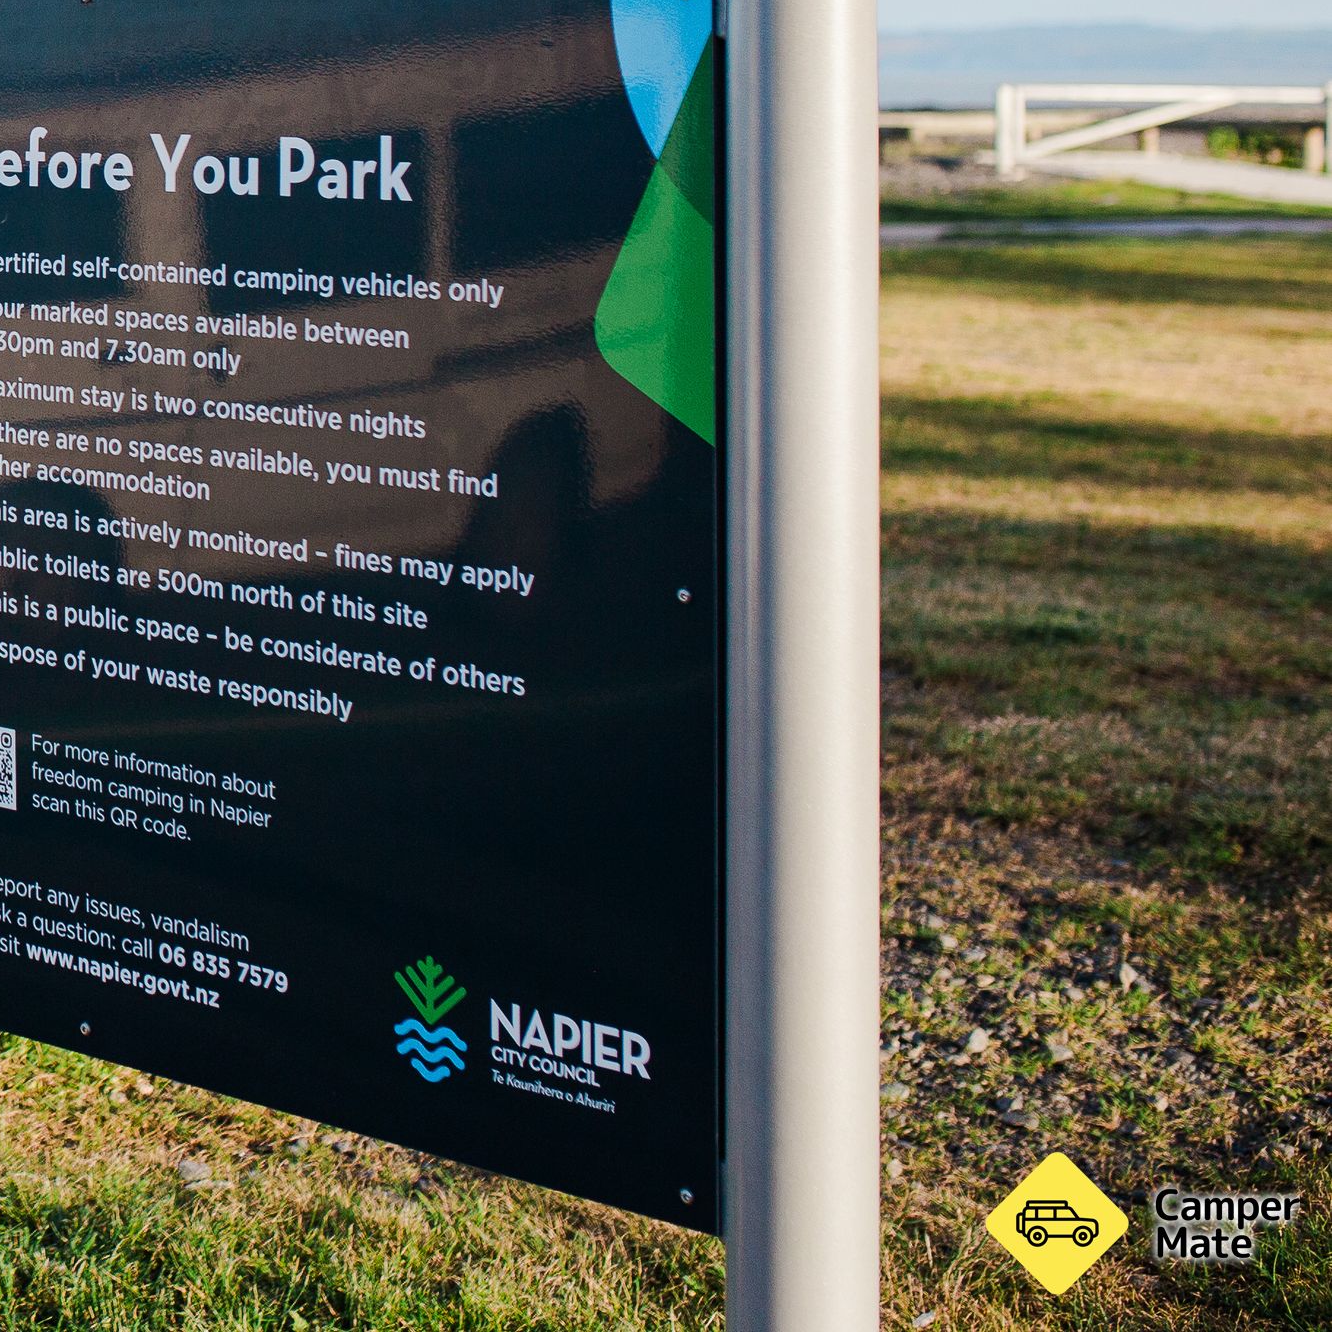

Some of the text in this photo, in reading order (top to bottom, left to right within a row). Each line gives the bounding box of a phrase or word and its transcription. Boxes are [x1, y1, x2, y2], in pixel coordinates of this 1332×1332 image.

[149, 133, 259, 196] You
[279, 134, 413, 202] Park
[72, 256, 227, 287] self-contained
[233, 267, 334, 298] camping
[341, 271, 442, 300] vehicles
[448, 278, 505, 309] only
[30, 301, 108, 326] marked
[114, 310, 189, 333] spaces
[194, 313, 298, 341] available
[304, 317, 410, 349] between
[60, 337, 99, 360] and
[106, 338, 186, 367] 7.30am
[192, 347, 242, 376] only
[80, 385, 125, 413] stay
[131, 387, 148, 411] is
[153, 390, 197, 416] two
[202, 399, 343, 431] consecutive
[349, 409, 426, 440] nights
[36, 463, 210, 501] accommodation
[55, 432, 89, 452] are
[95, 436, 123, 456] no
[128, 440, 204, 465] spaces
[209, 447, 319, 482] available,
[326, 461, 371, 485] you
[379, 467, 441, 492] must
[447, 468, 498, 498] find
[23, 508, 68, 530] area
[74, 509, 91, 533] is
[96, 516, 182, 549] actively
[188, 529, 308, 563] monitored
[334, 542, 393, 574] fines
[400, 557, 454, 586] may
[461, 565, 535, 597] apply
[44, 553, 110, 583] toilets
[116, 567, 151, 589] are
[157, 568, 224, 600] 500m
[231, 583, 293, 610] north
[300, 590, 326, 614] of
[331, 593, 376, 622] this
[383, 601, 428, 630] site
[24, 594, 40, 618] is
[45, 603, 58, 621] a
[64, 604, 129, 633] public
[135, 617, 200, 644] space
[225, 625, 254, 653] be
[260, 637, 402, 676] considerate
[409, 657, 436, 682] of
[442, 663, 526, 696] others
[63, 649, 86, 672] of
[91, 657, 140, 681] your
[146, 666, 211, 694] waste
[218, 678, 353, 723] responsibly
[31, 733, 276, 800] For more information about
[31, 761, 272, 828] freedom camping in Napier
[32, 793, 191, 841] scan this QR code.
[16, 911, 27, 928] a
[32, 914, 118, 950] question:
[121, 937, 153, 960] call
[158, 942, 186, 968] 06
[192, 950, 230, 979] 835
[236, 961, 289, 993] 7579
[47, 888, 80, 913] any
[83, 892, 145, 929] issues,
[149, 913, 250, 952] vandalism
[25, 942, 221, 1009] www.napier.govt.nz
[490, 997, 651, 1079] NAPIER
[491, 1045, 601, 1088] CITY COUNCIL
[491, 1068, 616, 1114] Te Kaunihera o Ahuriri
